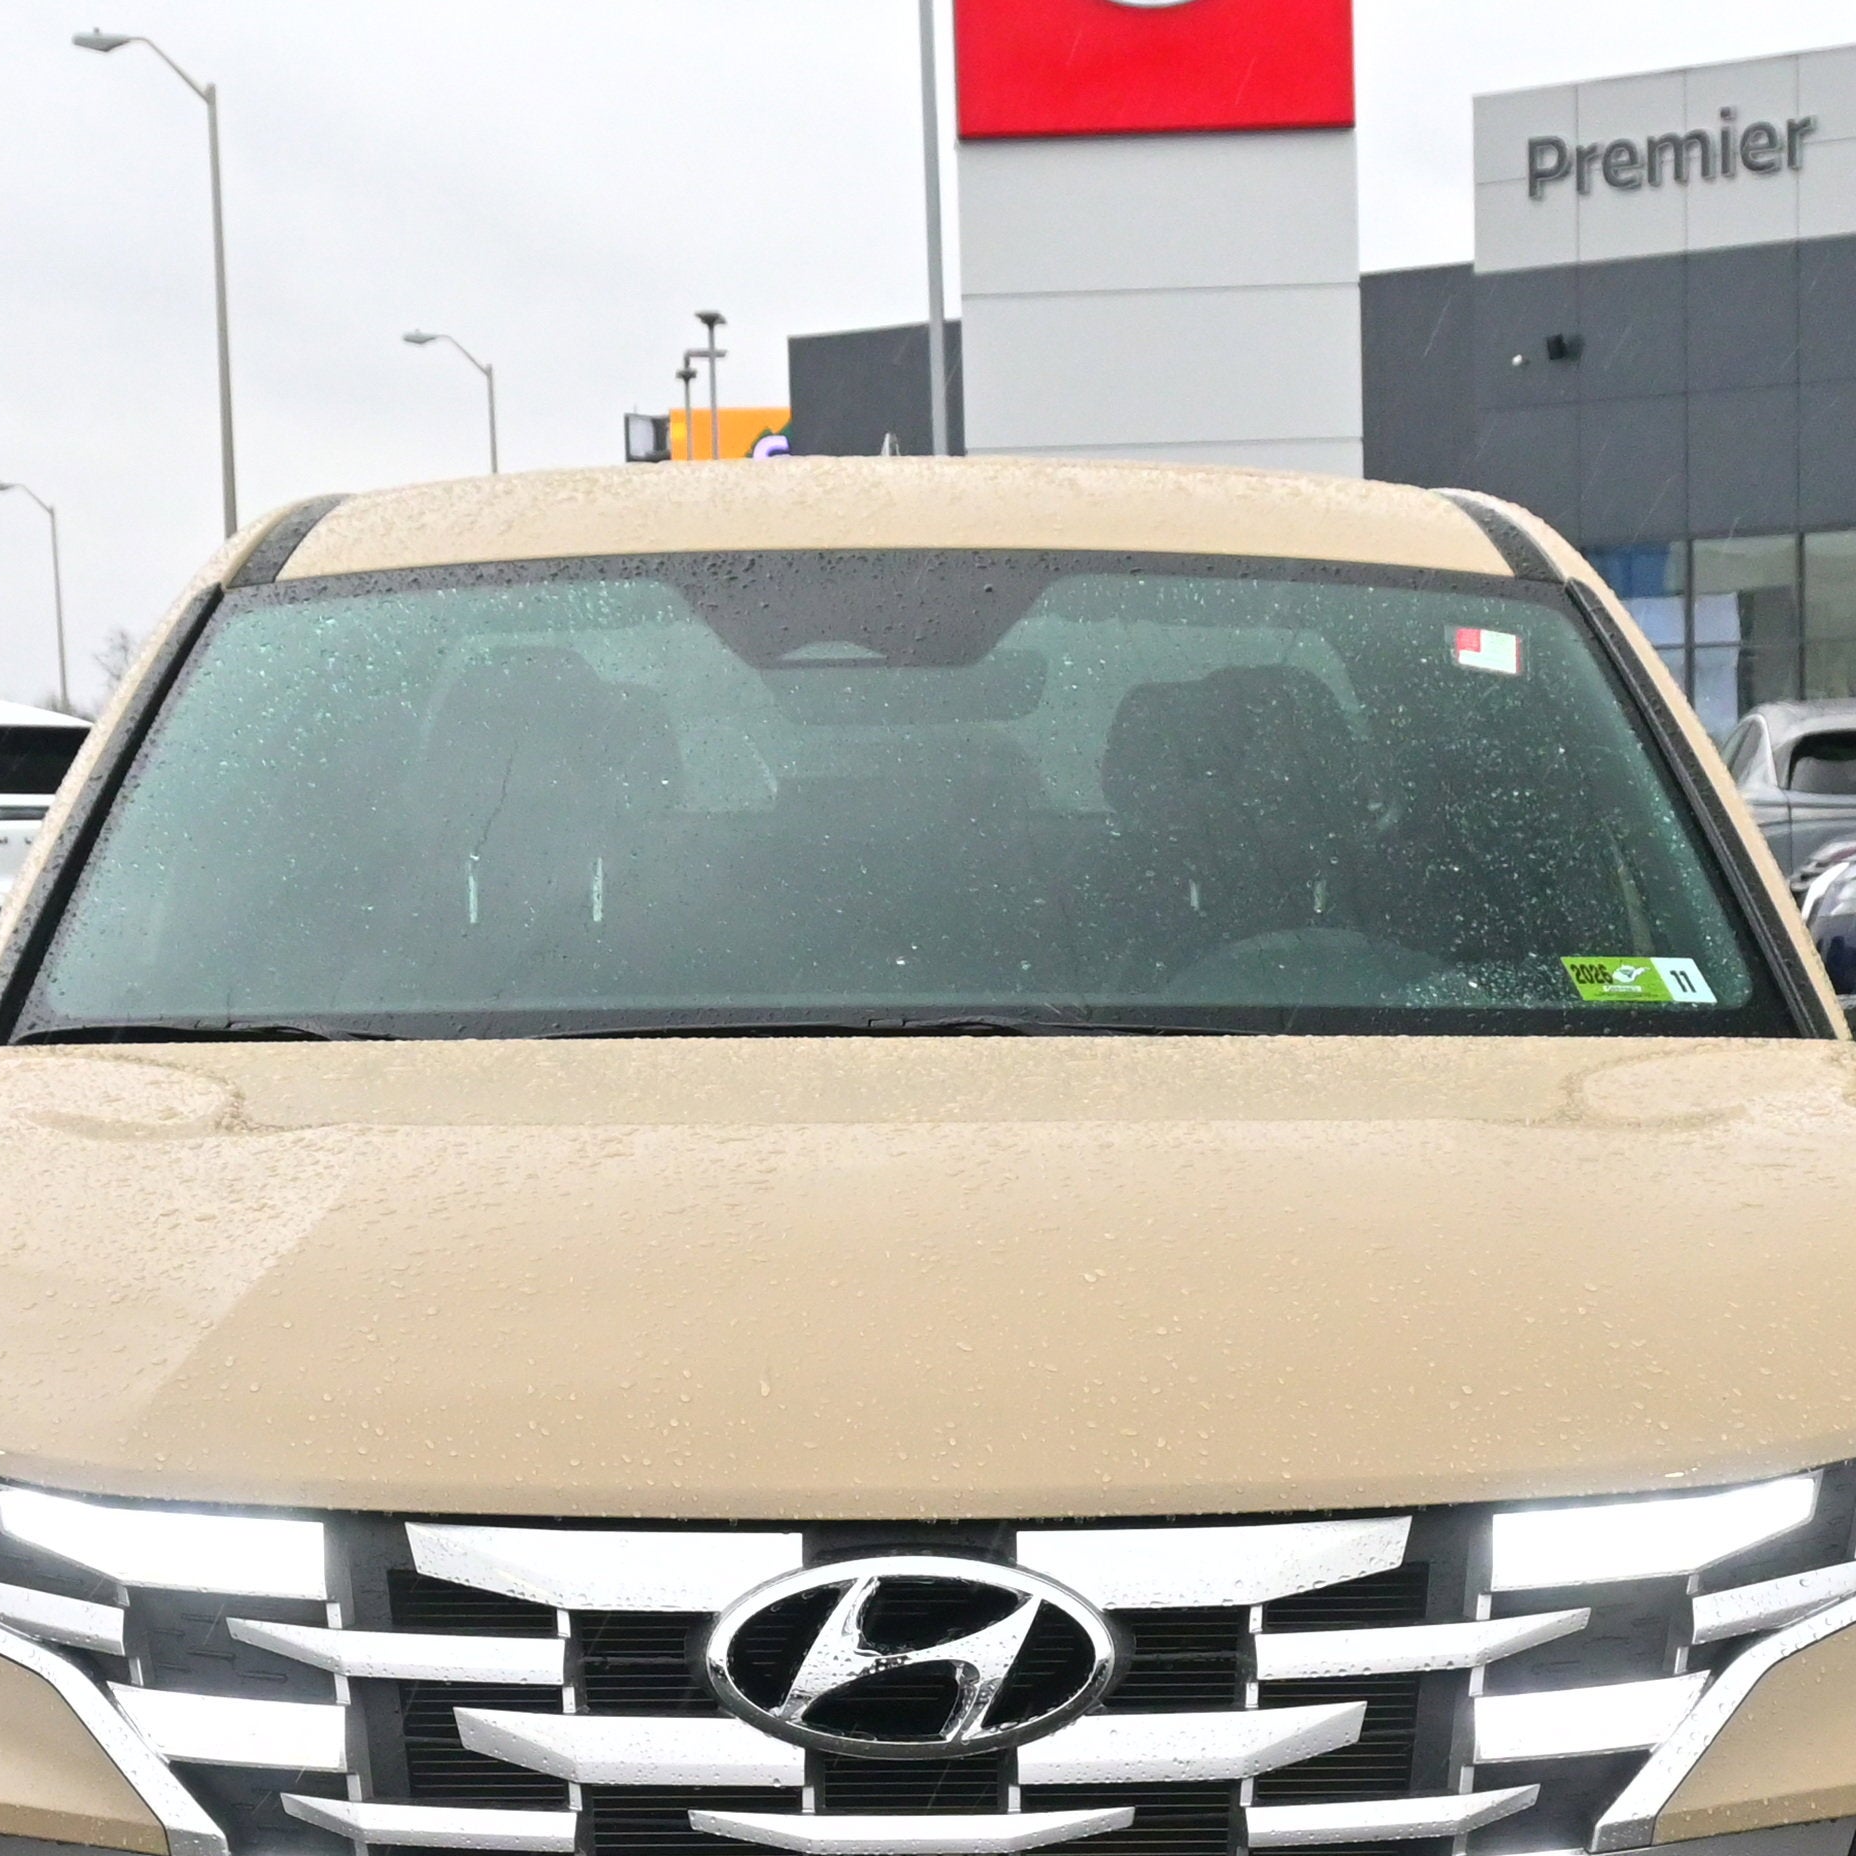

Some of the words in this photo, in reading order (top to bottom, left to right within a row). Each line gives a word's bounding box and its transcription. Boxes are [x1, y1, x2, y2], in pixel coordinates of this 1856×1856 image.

[1528, 105, 1817, 200] Premier
[1570, 963, 1614, 985] 2026
[1670, 970, 1697, 994] 11
